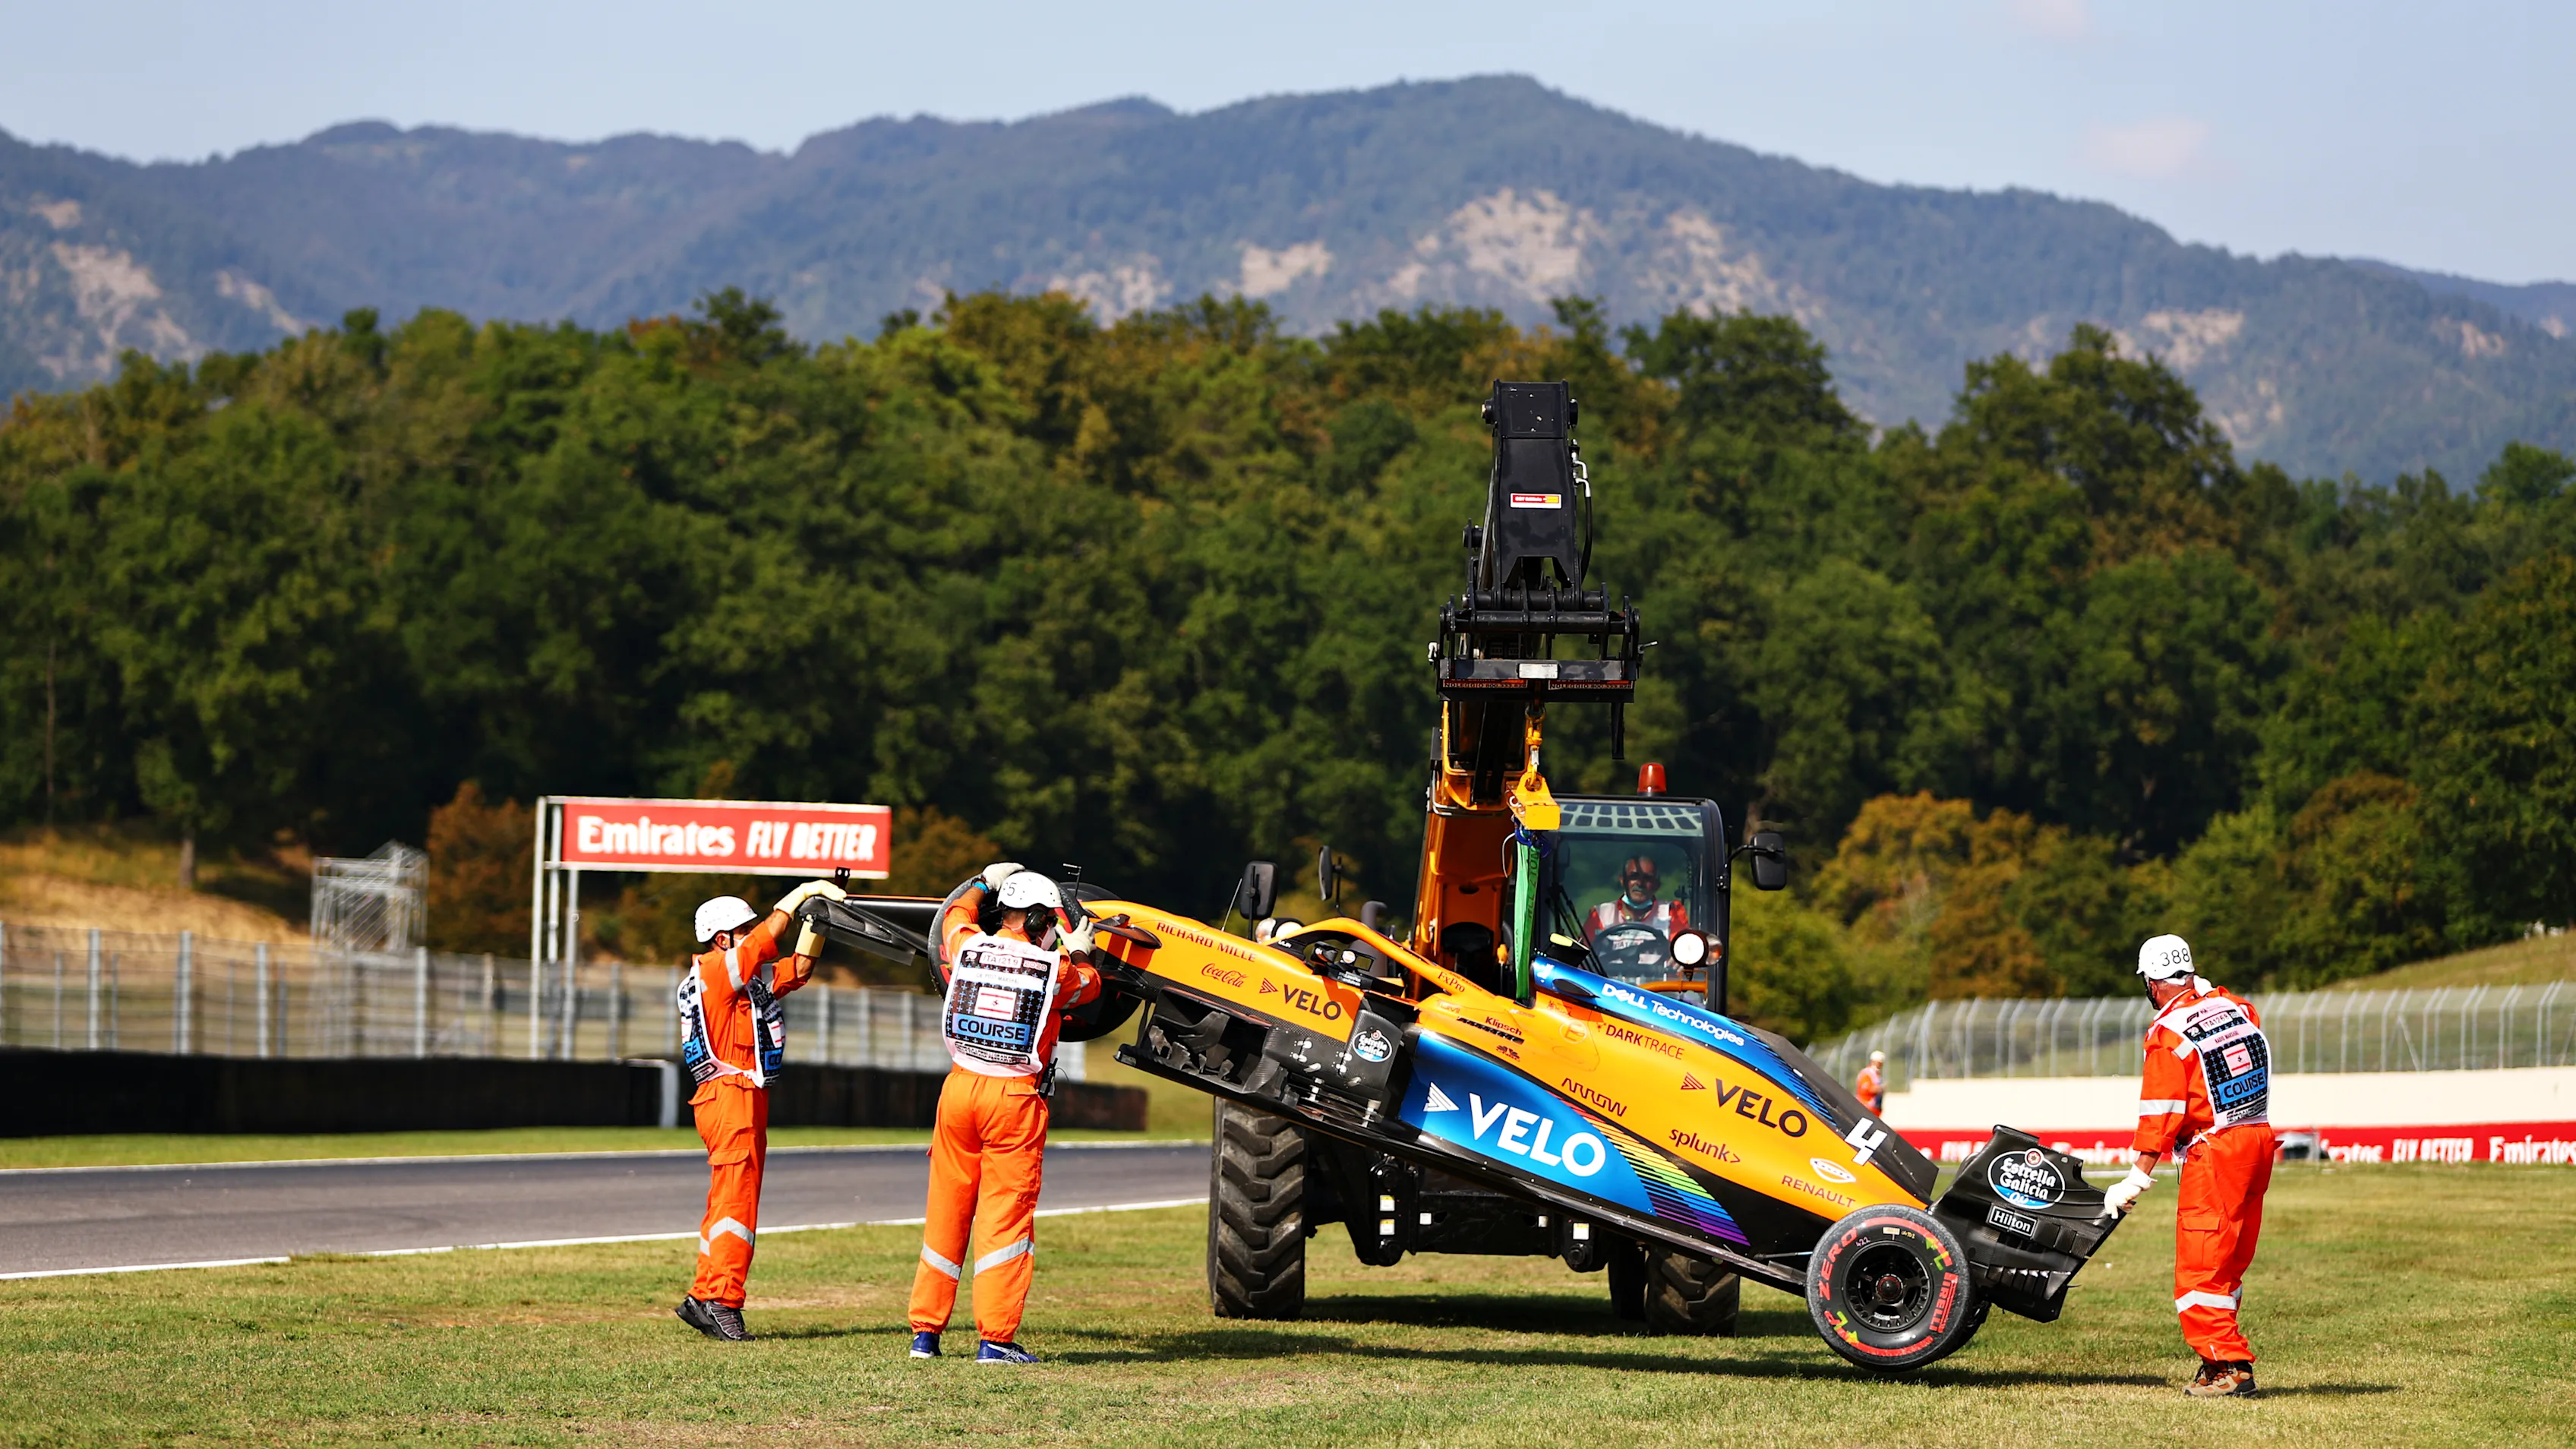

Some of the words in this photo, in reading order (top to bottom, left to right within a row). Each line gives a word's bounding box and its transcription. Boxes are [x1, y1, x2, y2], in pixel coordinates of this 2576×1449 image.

[577, 816, 736, 857] Emirates
[746, 820, 790, 858] FLY
[790, 822, 878, 861] BETTER
[1157, 922, 1214, 948] RICHARD
[1217, 942, 1258, 962] MILLE
[2160, 948, 2190, 967] 388
[1438, 971, 1466, 993] FxPro
[1283, 983, 1341, 1020] VELO
[1602, 983, 1647, 1009] DELL
[1651, 1000, 1744, 1046] Technologies
[958, 1018, 1025, 1041] COURSE
[1485, 1016, 1522, 1036] Klipsch
[1605, 1024, 1685, 1060] DARKTRACE
[1715, 1078, 1807, 1138] VELO
[1469, 1092, 1605, 1176] VELO
[1845, 1116, 1888, 1166] 4
[2000, 1157, 2056, 1187] Estrella
[2000, 1172, 2048, 1200] Galicia
[1781, 1174, 1856, 1208] RENAULT
[1994, 1211, 2031, 1232] Hilton
[1855, 1236, 1871, 1247] 422
[1818, 1226, 1858, 1301] ZERO
[1929, 1272, 1959, 1334] PIRELLI
